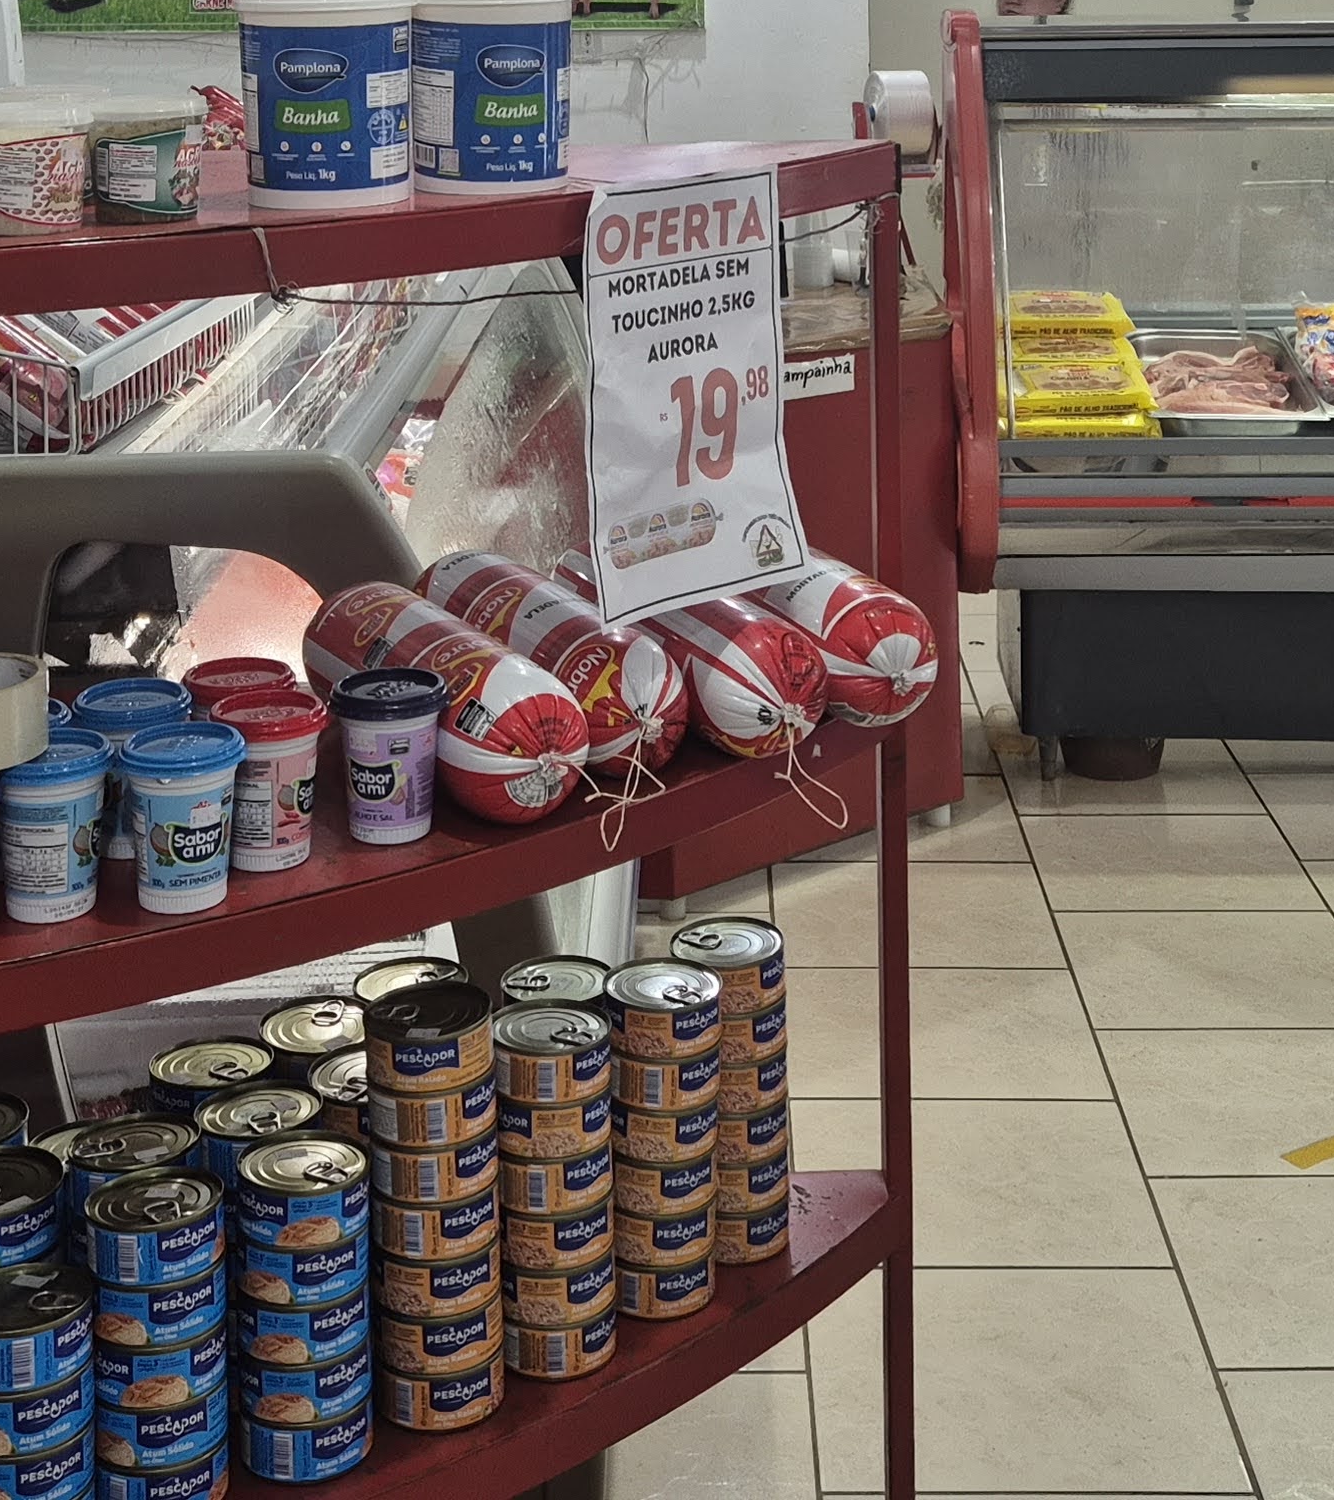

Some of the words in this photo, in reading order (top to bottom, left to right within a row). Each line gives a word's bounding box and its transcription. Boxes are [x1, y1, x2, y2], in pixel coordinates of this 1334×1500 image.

[280, 62, 341, 78] Pamplona
[484, 56, 540, 72] Pamplona
[283, 107, 340, 126] Banha
[484, 102, 538, 119] Banha
[319, 169, 336, 183] 1kg
[518, 161, 534, 173] 1kg
[596, 196, 765, 265] OFERTA
[608, 266, 711, 298] MORTADELA
[715, 258, 750, 280] SEM
[612, 301, 703, 333] TOUCINHO
[708, 291, 755, 317] 2,5KG
[647, 332, 718, 363] AURORA
[784, 360, 853, 389] ampainha
[352, 767, 393, 785] Sabor
[358, 781, 386, 796] ami
[173, 828, 220, 849] Sabor
[182, 841, 215, 859] ami
[675, 1010, 718, 1031] PESCADOR
[395, 1050, 456, 1066] PESCADOR
[162, 1222, 215, 1251] PESCADOR
[558, 1216, 607, 1240] PESCADOR
[657, 1220, 706, 1240] PESCADOR
[297, 1251, 354, 1274] PESCADOR
[153, 1285, 212, 1312] PESCADOR
[427, 1322, 484, 1345] PESCADOR
[18, 1390, 80, 1422] PESCADOR
[141, 1411, 204, 1436] PESCADOR
[142, 1449, 166, 1460] Atum
[20, 1452, 82, 1484] PESCADOR
